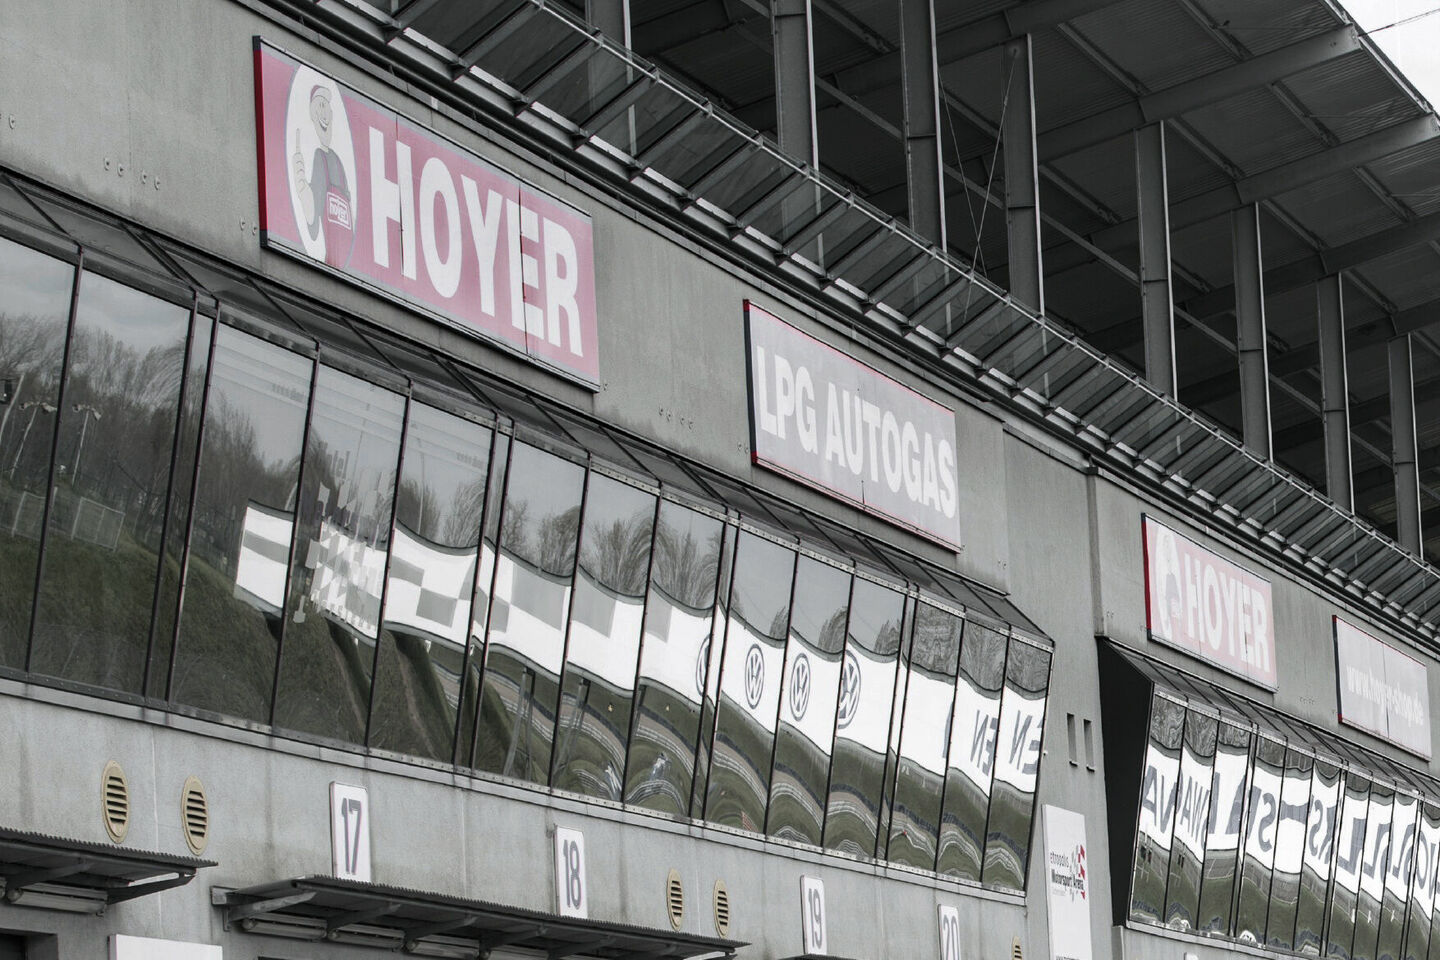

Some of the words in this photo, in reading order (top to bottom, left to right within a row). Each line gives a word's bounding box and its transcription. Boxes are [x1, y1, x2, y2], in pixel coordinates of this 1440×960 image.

[369, 127, 583, 356] HOYER
[756, 346, 818, 454] LPG
[825, 382, 957, 518] AUTOGAS
[1184, 552, 1270, 673] HOYER
[341, 797, 362, 876] 17
[563, 839, 582, 910] 18
[808, 888, 823, 949] 19
